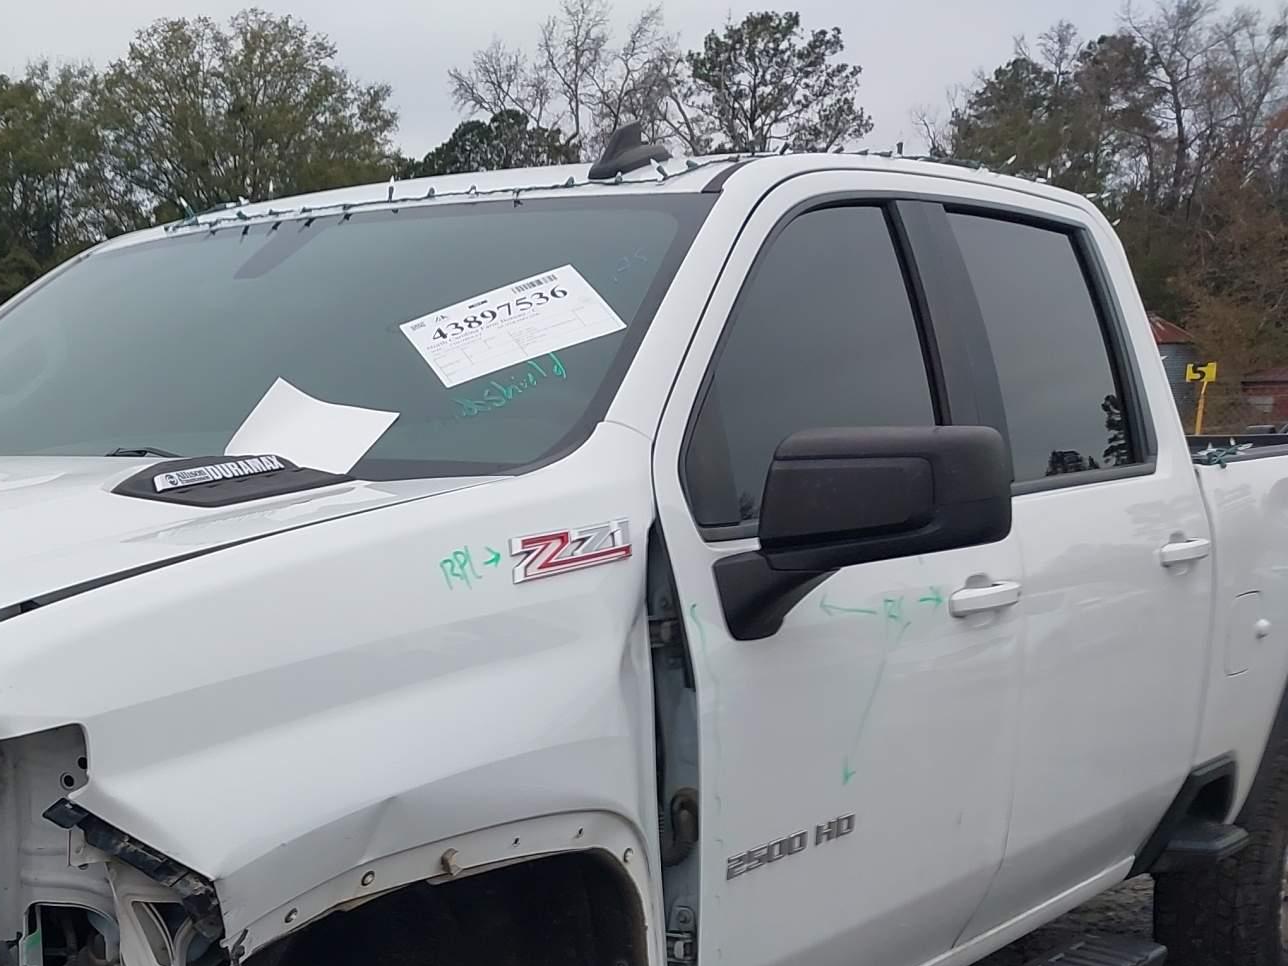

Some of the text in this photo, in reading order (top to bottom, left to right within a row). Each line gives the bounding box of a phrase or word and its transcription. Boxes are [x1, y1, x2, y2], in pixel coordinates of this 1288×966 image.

[432, 284, 568, 342] 43897536
[1190, 363, 1210, 381] 5
[208, 456, 285, 480] DURAMAX
[509, 517, 632, 584] Z71
[726, 811, 857, 881] 2500 HD
